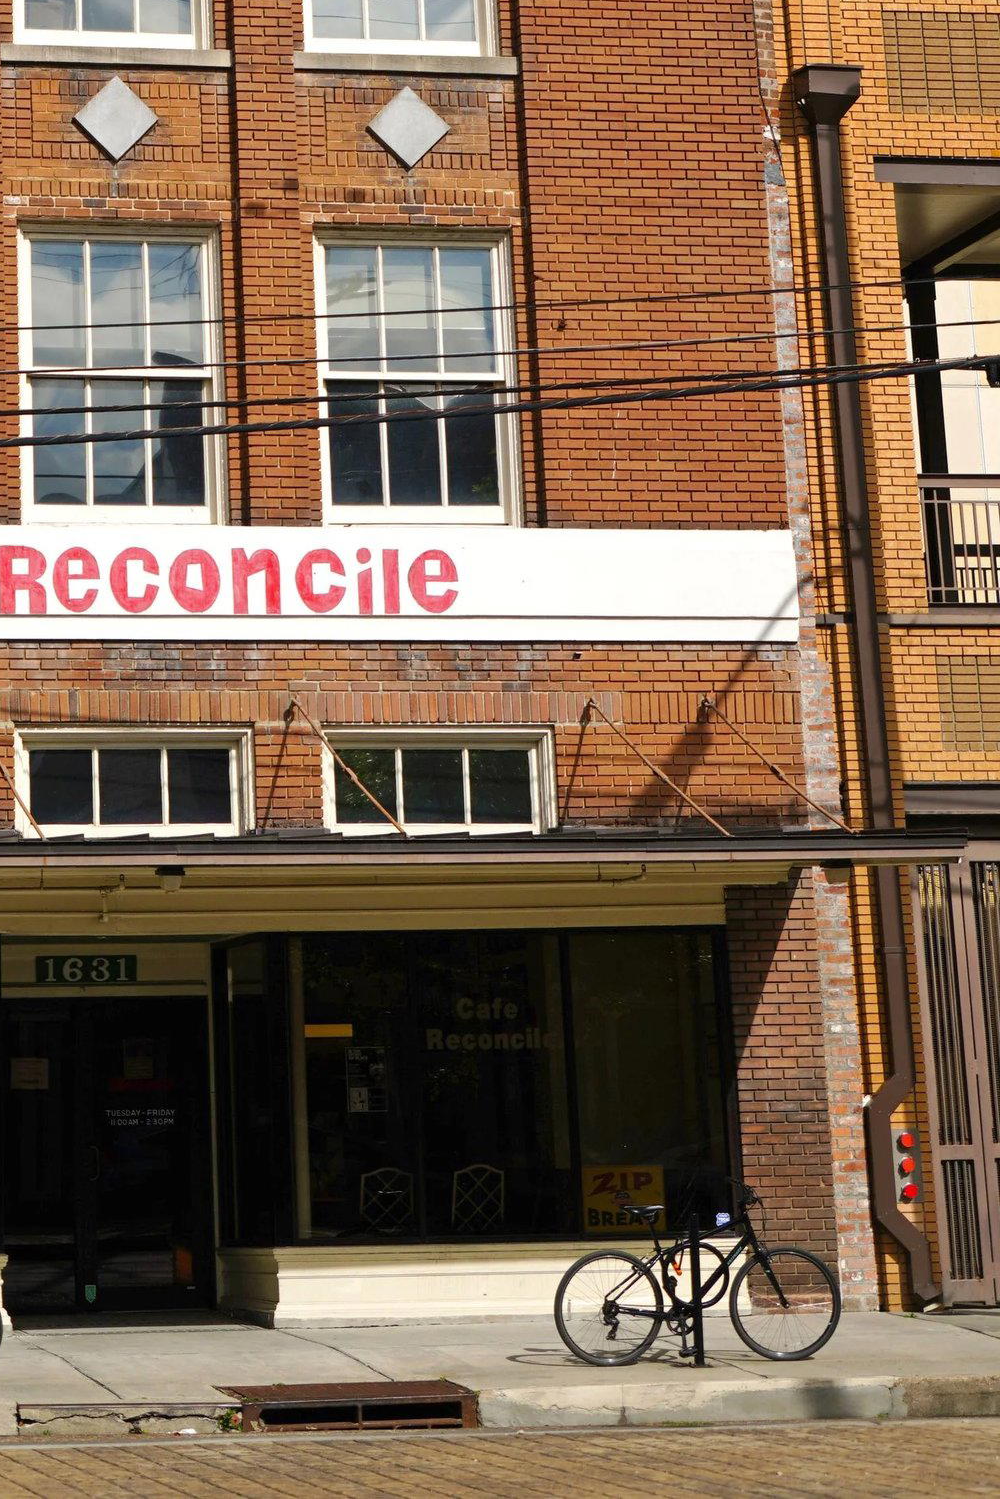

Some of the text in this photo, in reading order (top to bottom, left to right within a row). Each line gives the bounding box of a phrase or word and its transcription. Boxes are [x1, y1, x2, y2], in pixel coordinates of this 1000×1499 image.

[44, 957, 130, 982] 1631
[455, 997, 519, 1020] Cafe
[588, 1172, 654, 1197] ZIP
